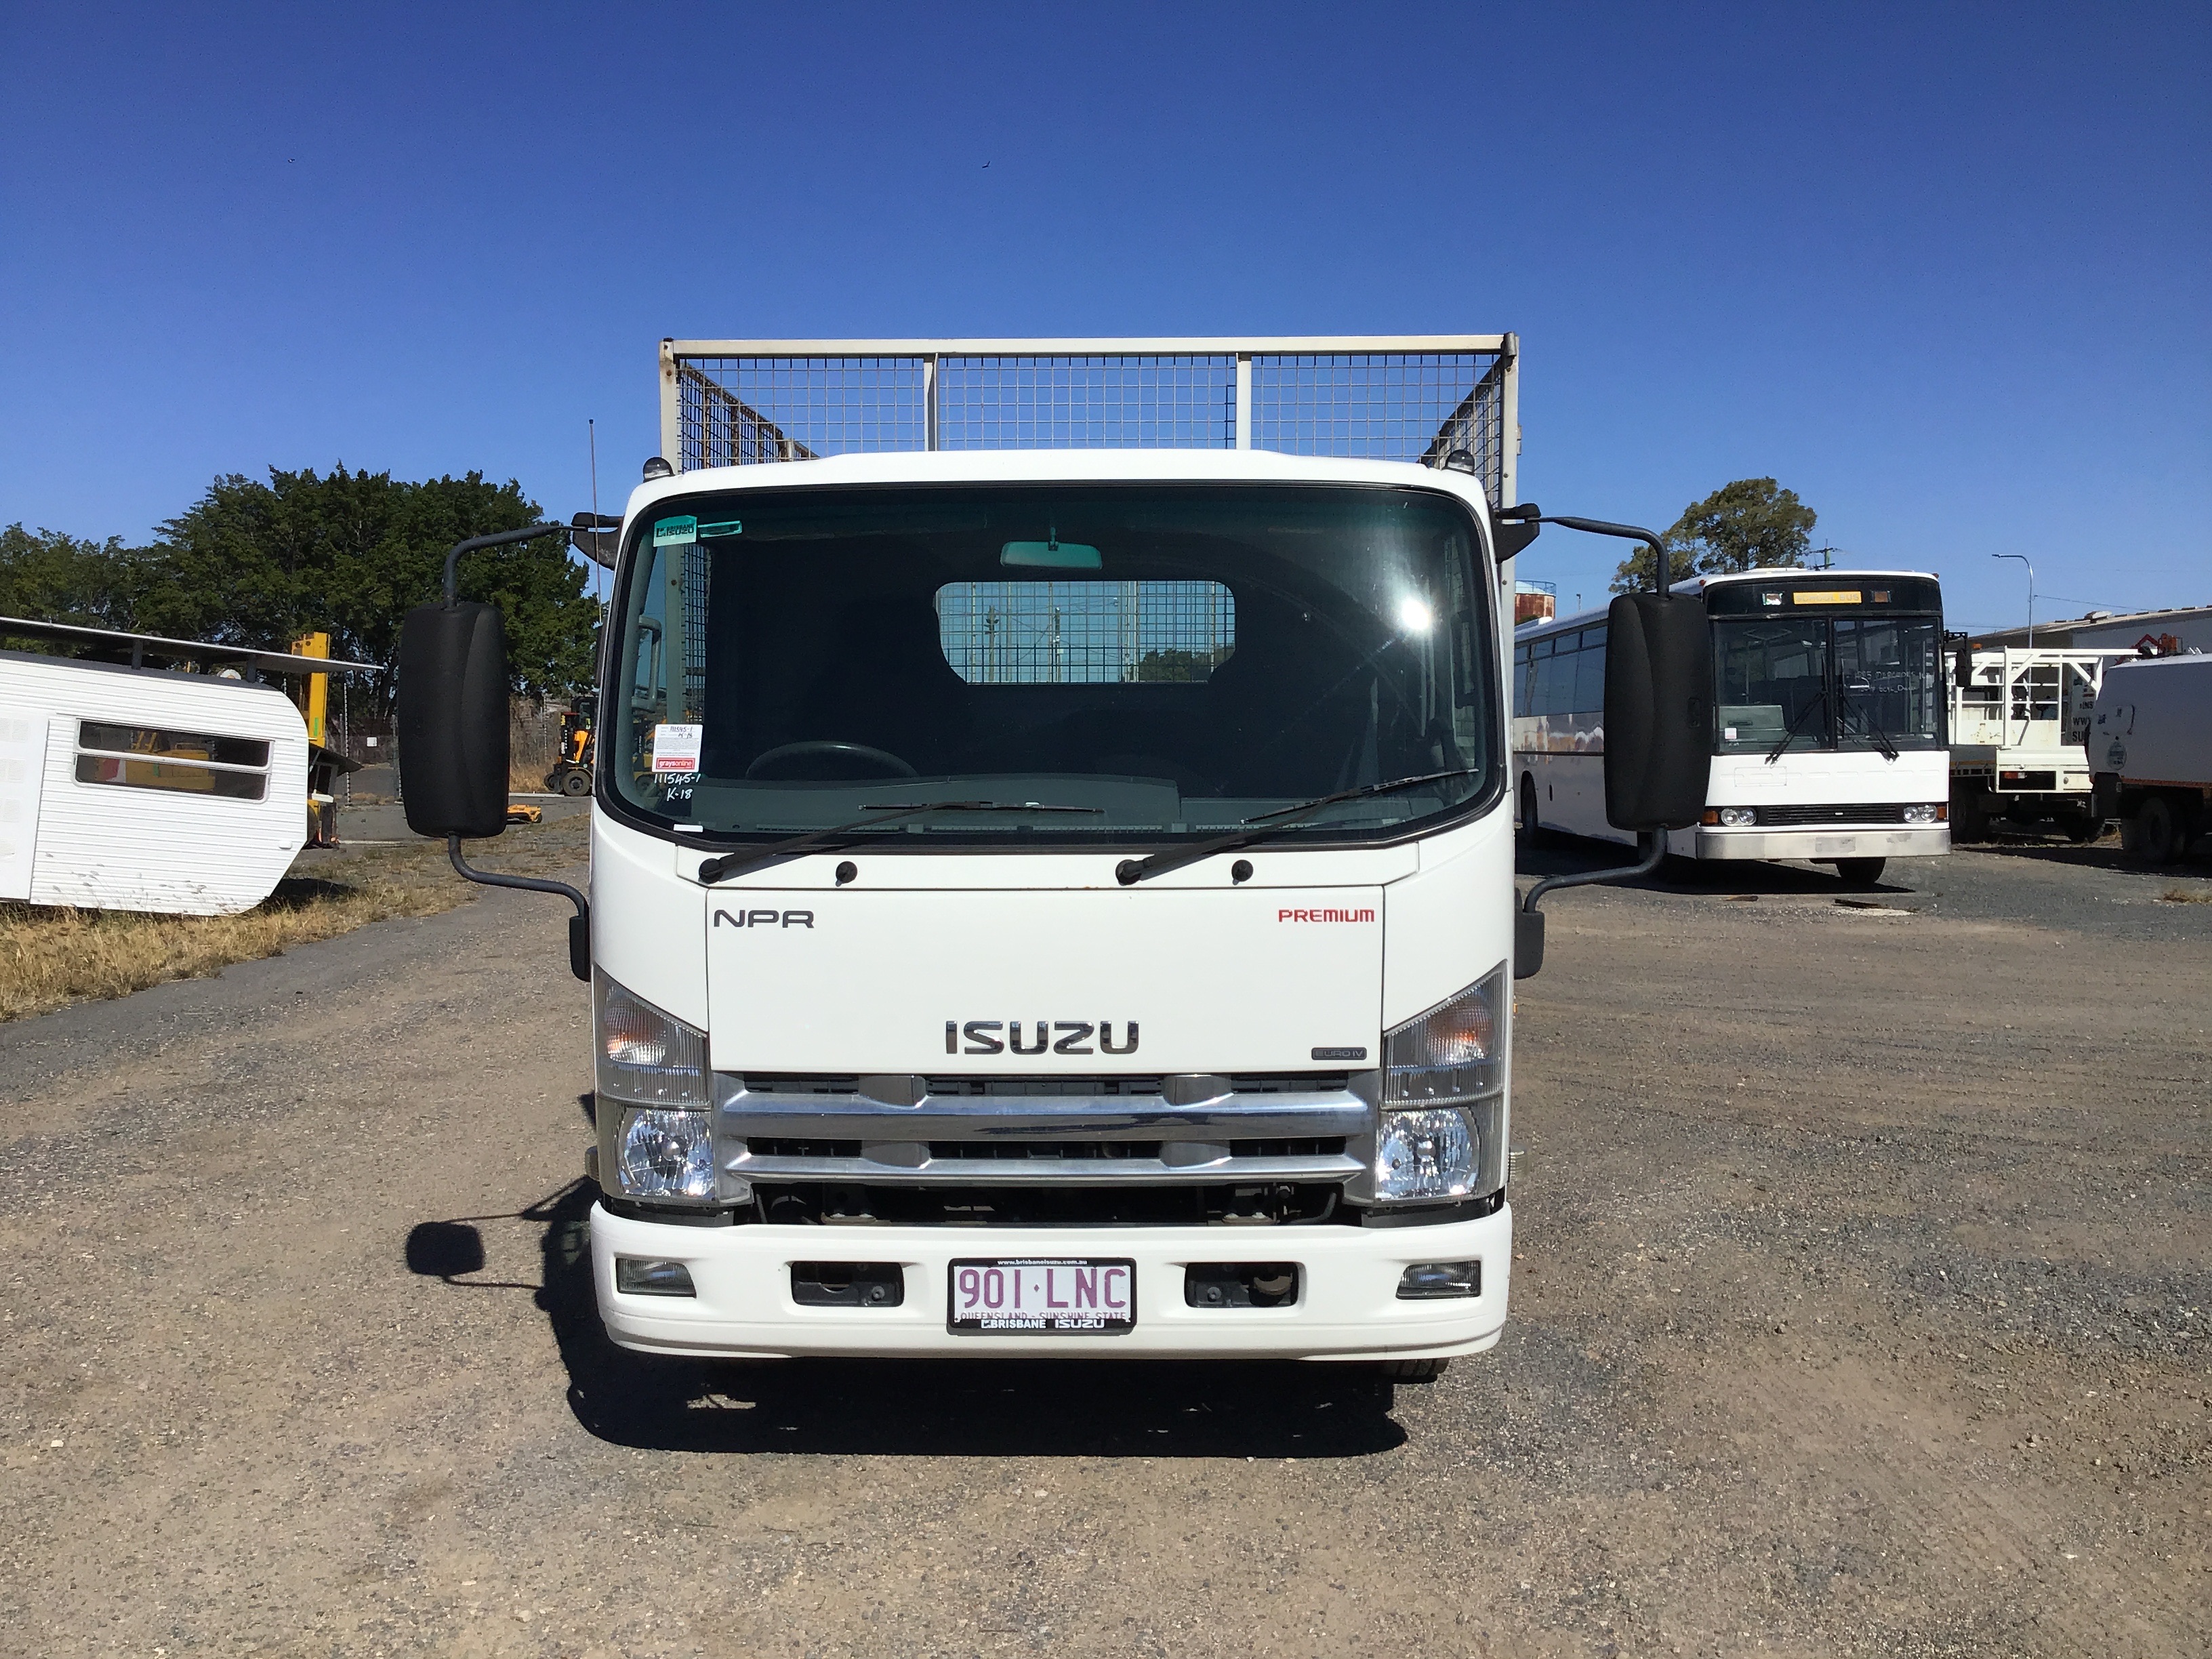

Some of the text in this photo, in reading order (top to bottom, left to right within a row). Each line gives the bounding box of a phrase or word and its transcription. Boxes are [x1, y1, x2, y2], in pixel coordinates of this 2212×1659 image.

[667, 527, 694, 536] ISUZU
[659, 760, 693, 768] graysonline
[654, 773, 701, 785] 111545-1
[667, 787, 693, 801] K-18
[714, 909, 815, 928] NPR
[1278, 909, 1375, 922] PREMIUM
[945, 1021, 1140, 1055] ISUZU
[960, 1311, 1028, 1319] QUEENSLAND
[1039, 1311, 1090, 1319] SUNSHINE
[1096, 1311, 1126, 1319] STATE
[990, 1319, 1105, 1329] BRISBANE ISUZU
